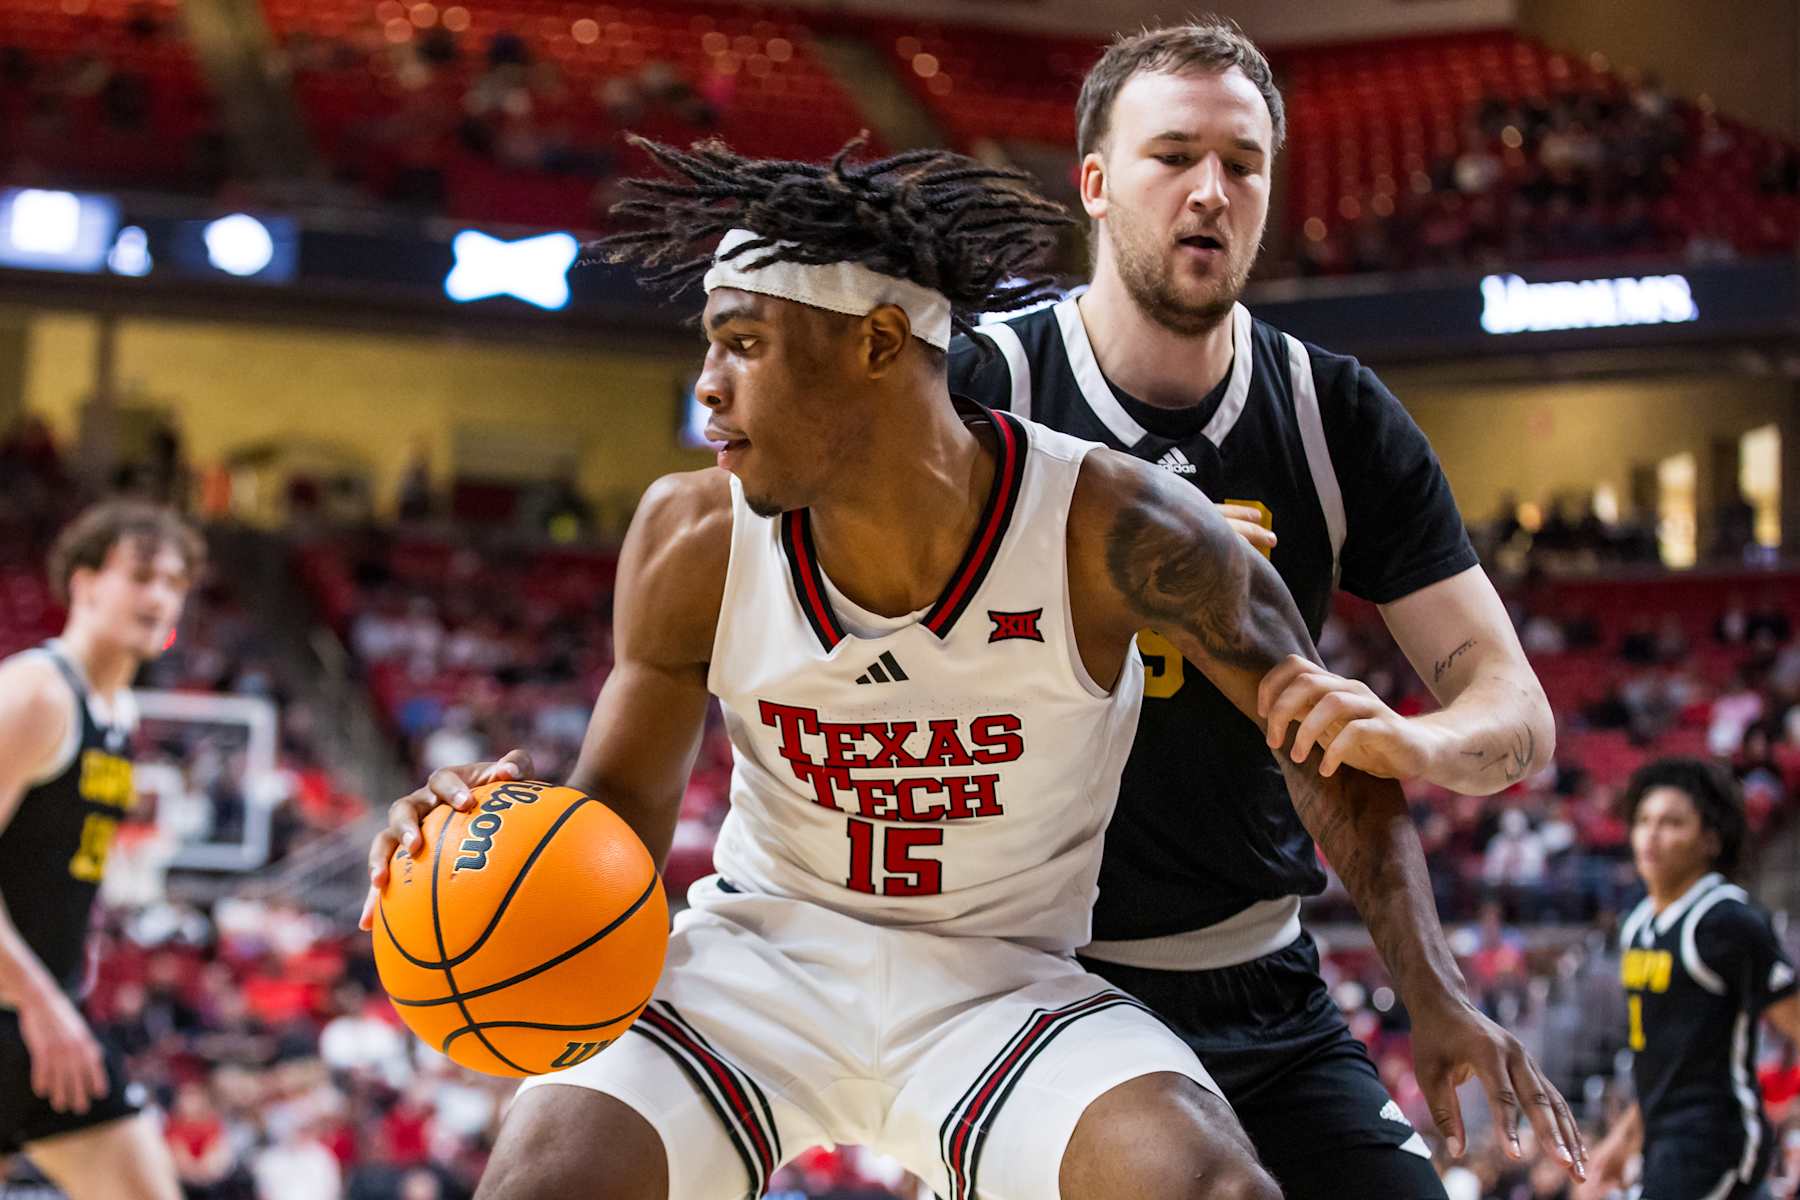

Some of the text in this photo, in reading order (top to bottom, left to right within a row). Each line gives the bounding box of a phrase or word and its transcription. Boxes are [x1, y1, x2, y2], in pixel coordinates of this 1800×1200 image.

[1158, 463, 1197, 474] didas
[758, 699, 1025, 769] TEXAS
[789, 757, 1004, 822] TECH
[454, 780, 552, 872] ilson
[846, 817, 944, 896] 15
